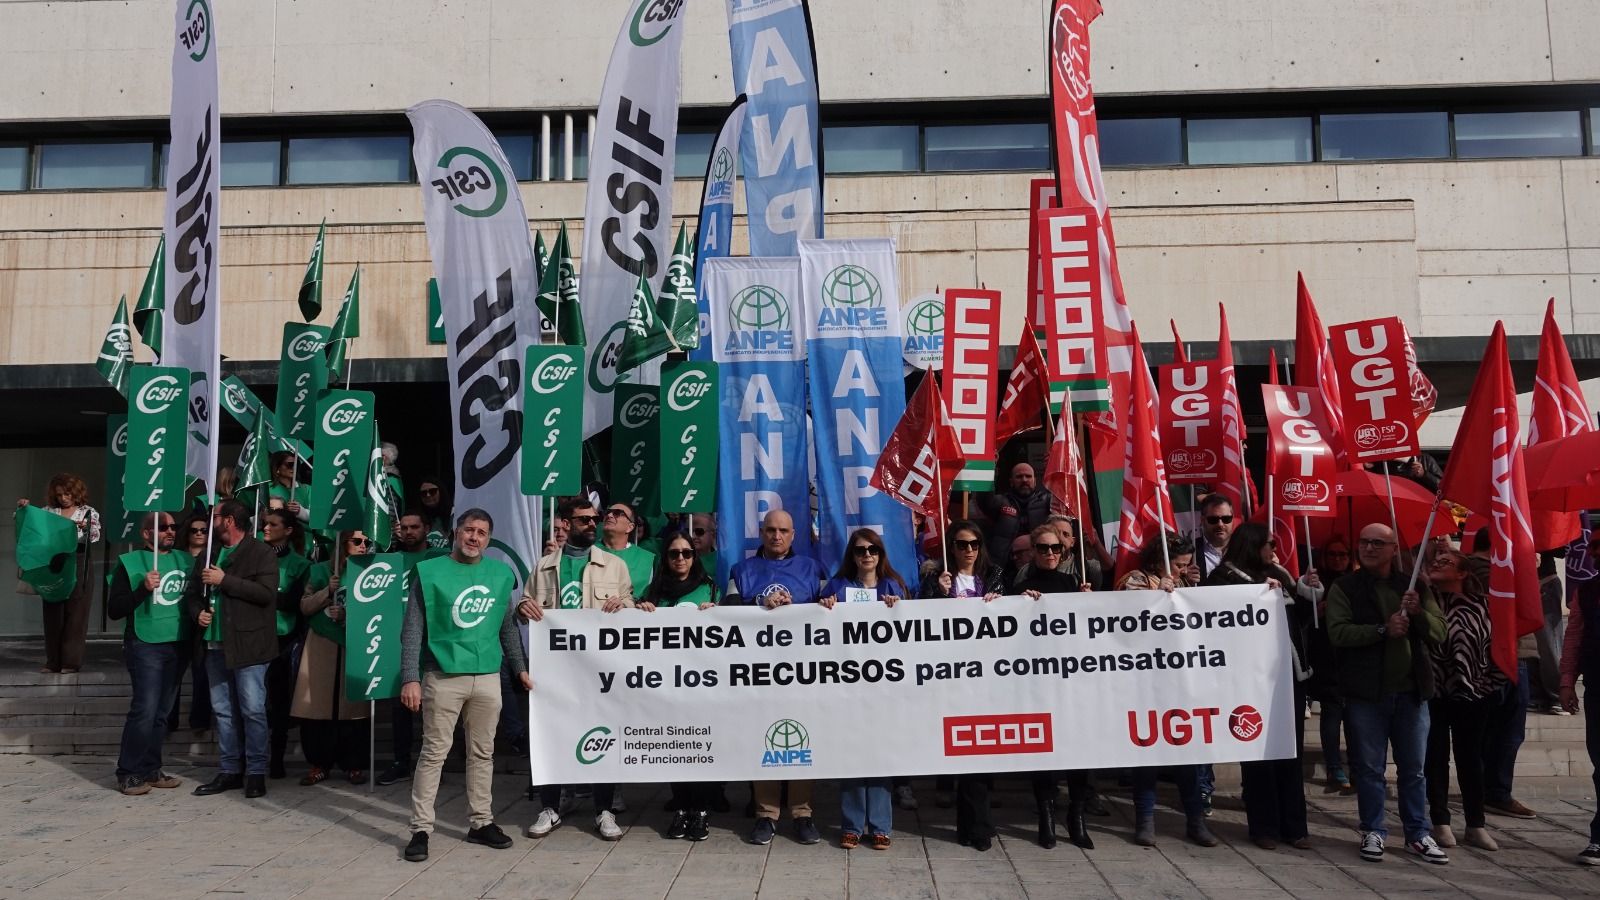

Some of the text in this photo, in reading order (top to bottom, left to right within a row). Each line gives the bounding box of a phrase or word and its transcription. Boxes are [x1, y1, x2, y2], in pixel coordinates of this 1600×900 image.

[601, 95, 665, 279] CSIF
[1049, 215, 1096, 375] CCOO
[817, 307, 887, 327] ANPE
[296, 338, 325, 353] CSIF
[725, 330, 793, 350] ANPE
[904, 336, 944, 350] ANP
[540, 366, 578, 381] CSIF
[951, 297, 991, 454] CCOO
[1344, 325, 1396, 420] UGT
[145, 387, 183, 401] CSIF
[676, 383, 712, 397] CSIF
[290, 372, 310, 435] CSIF
[628, 403, 660, 418] CSIF
[1171, 366, 1209, 447] UGT
[331, 408, 367, 424] CSIF
[1274, 391, 1324, 476] UGT
[1358, 427, 1377, 439] UGT
[1381, 425, 1396, 434] FSP
[541, 407, 561, 491] CSIF
[832, 350, 884, 536] ANP
[144, 427, 166, 506] CSIF
[680, 424, 697, 508] CSIF
[738, 374, 784, 540] ANP
[1171, 453, 1188, 463] UGT
[329, 449, 350, 526] CSIF
[1285, 482, 1319, 492] UGT FSP
[362, 574, 396, 588] CSIF
[460, 597, 495, 613] CSIF
[549, 603, 1269, 651] En DEFENSA de la MOVILIDAD del profesorado
[366, 614, 382, 695] CSIF
[598, 645, 1226, 694] y de los RECURSOS para compensatoria
[624, 725, 711, 736] Central Sindical
[951, 722, 1045, 747] CCOO
[1127, 707, 1220, 747] UGT
[583, 738, 616, 752] CSIF
[624, 740, 713, 752] Independiente y
[624, 754, 714, 765] de Funcionarios
[762, 750, 812, 764] ANPE
